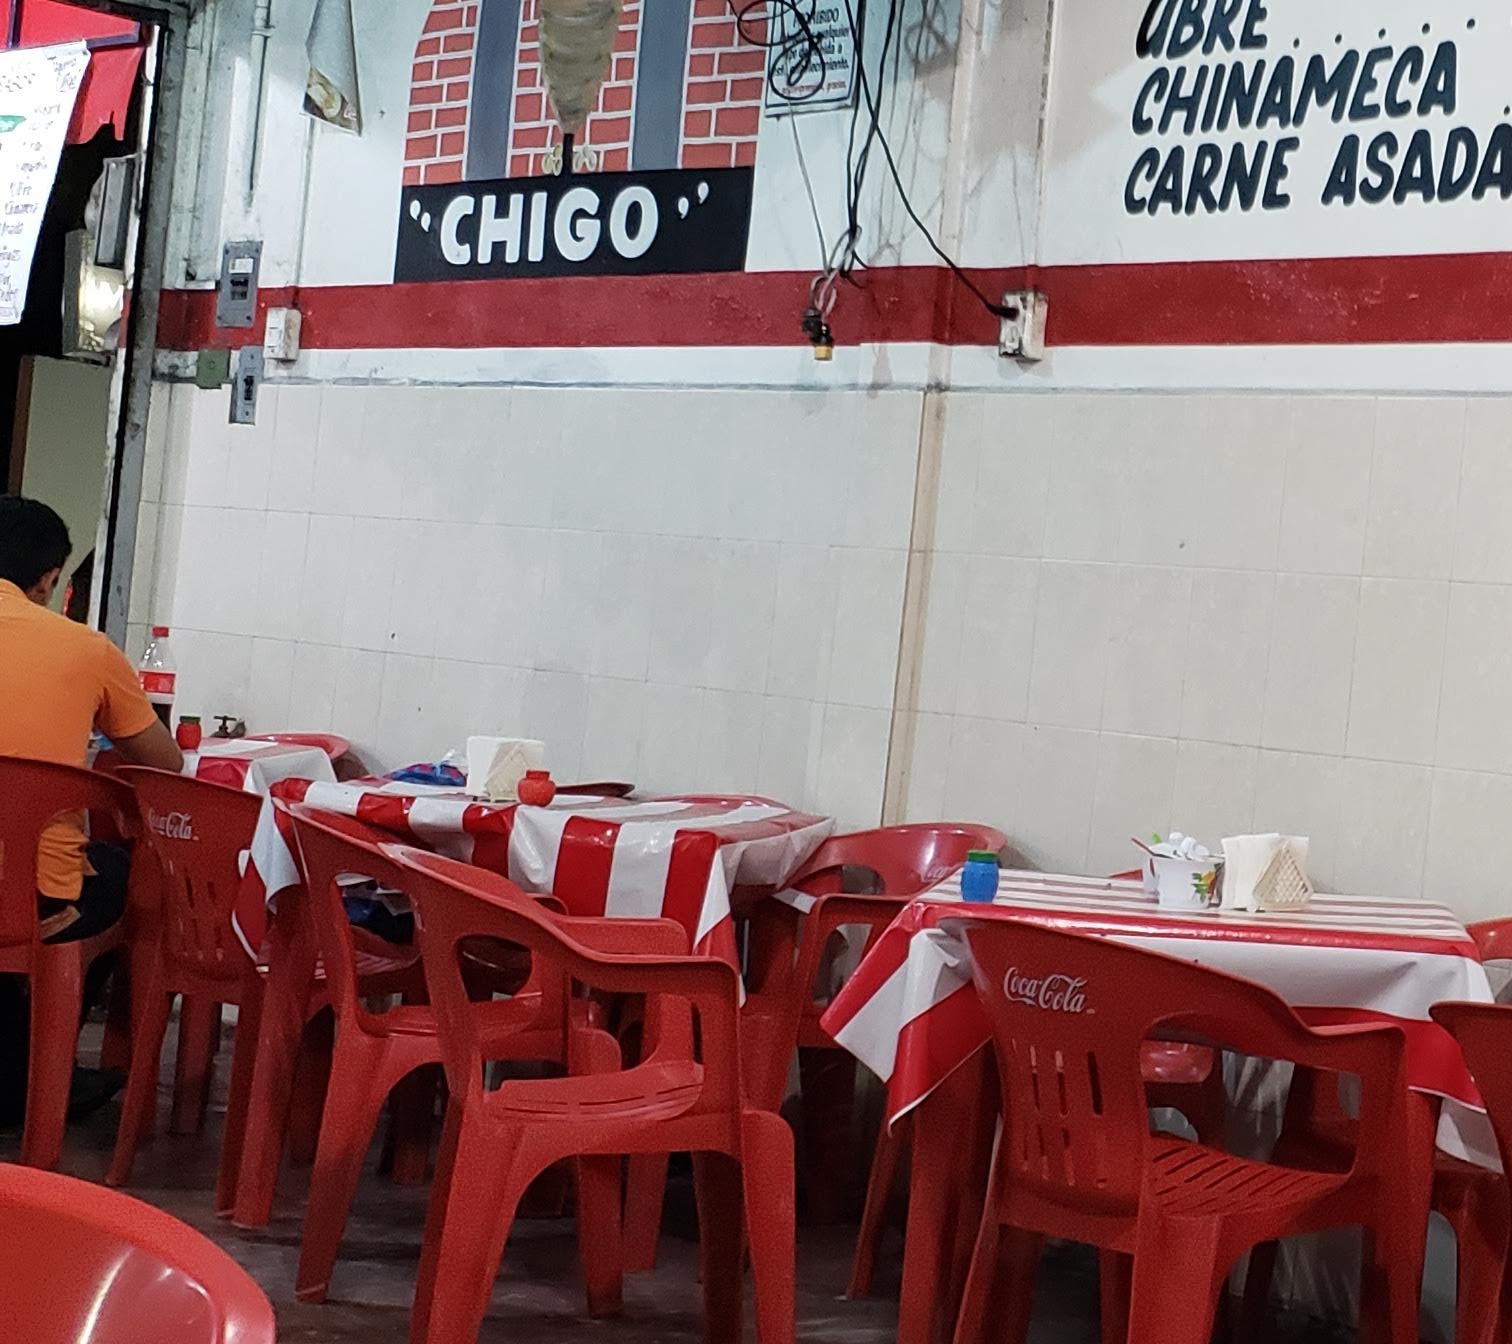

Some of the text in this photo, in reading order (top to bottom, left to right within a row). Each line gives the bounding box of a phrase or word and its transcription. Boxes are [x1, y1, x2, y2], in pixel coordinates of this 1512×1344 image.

[1131, 40, 1457, 135] CHINAMECA
[1124, 136, 1300, 216] CARNE
[1003, 966, 1088, 1013] Coca-Cola
